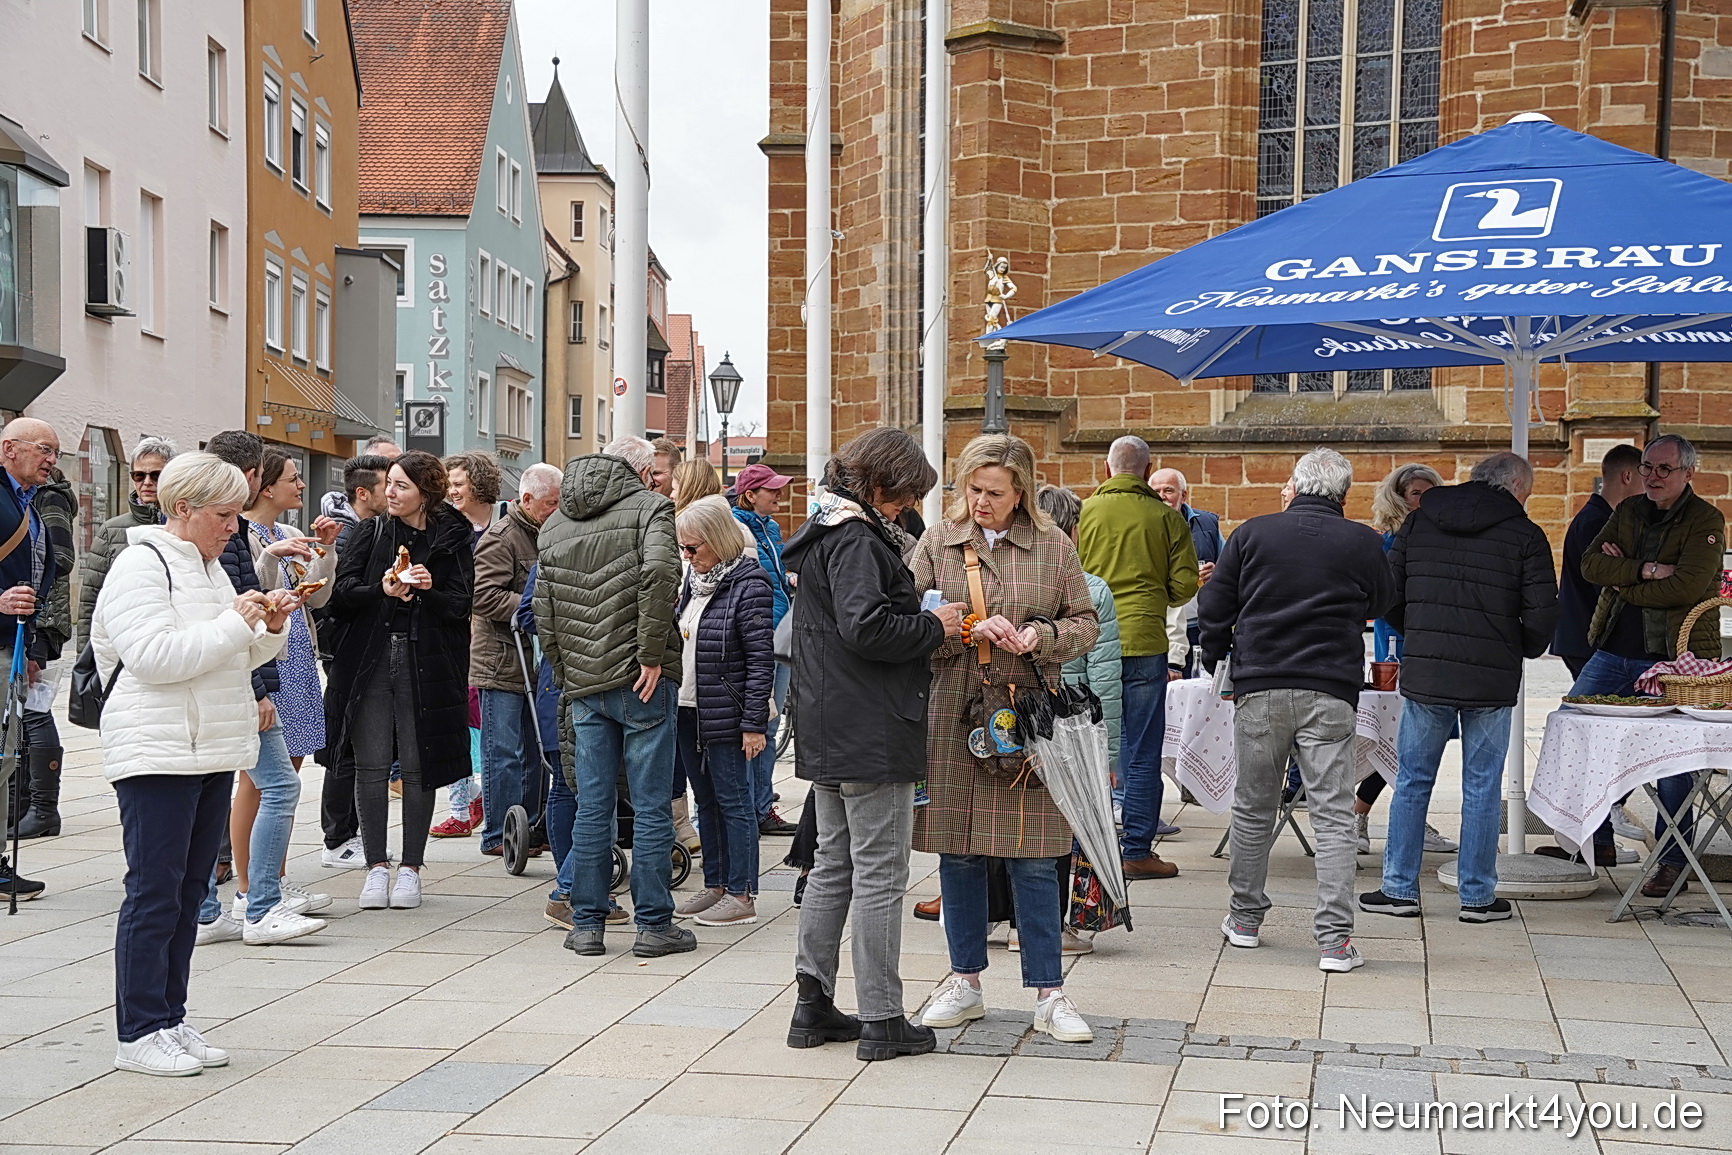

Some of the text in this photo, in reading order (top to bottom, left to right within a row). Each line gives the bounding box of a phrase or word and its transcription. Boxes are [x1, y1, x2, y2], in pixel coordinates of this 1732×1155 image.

[1264, 243, 1723, 281] GANSBRÄU
[1164, 275, 1732, 316] Neumarkt's guter Schlu
